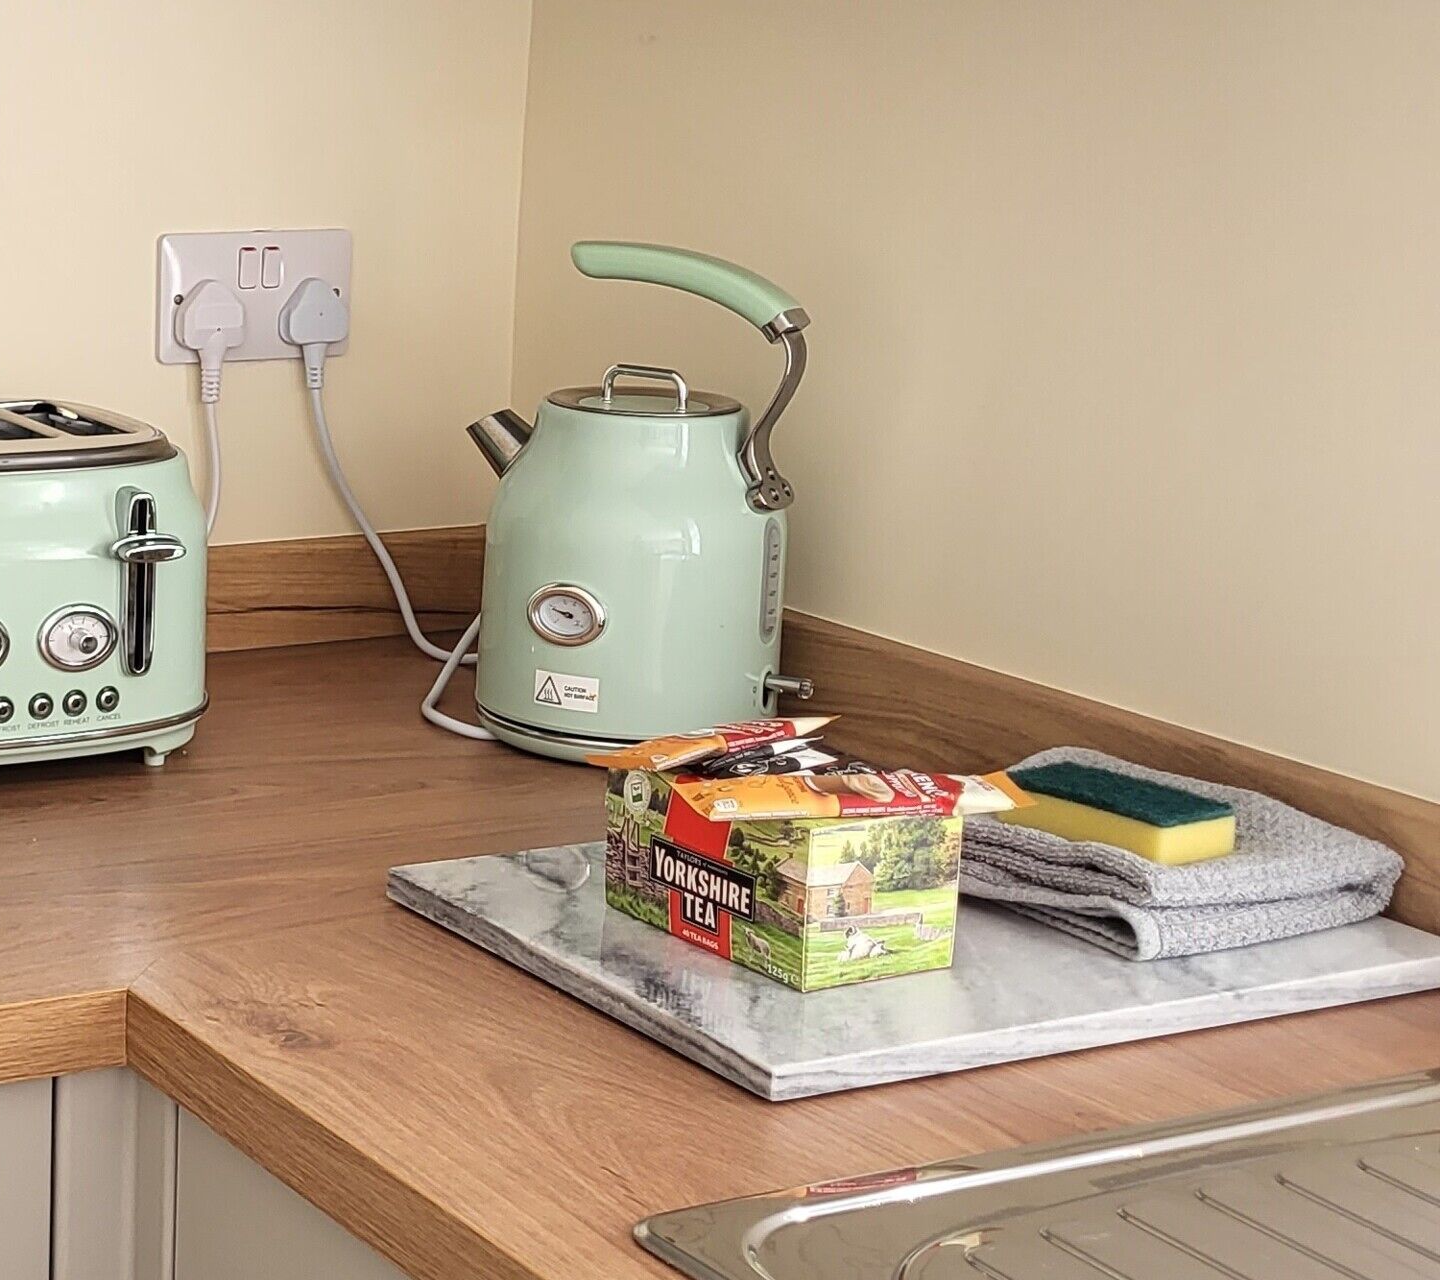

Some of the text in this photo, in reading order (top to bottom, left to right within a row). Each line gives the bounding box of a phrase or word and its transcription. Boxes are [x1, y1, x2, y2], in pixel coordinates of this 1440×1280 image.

[564, 685, 587, 693] CAUTION
[27, 720, 60, 730] DEFROST
[63, 716, 91, 726] REHEAT
[96, 713, 122, 722] CANCEL
[675, 849, 702, 867] TAYLORS
[654, 845, 751, 915] YORKSHIRE
[684, 892, 716, 930] TEA
[689, 931, 702, 942] TEA
[702, 936, 720, 951] BAGS
[767, 964, 789, 985] 125g
